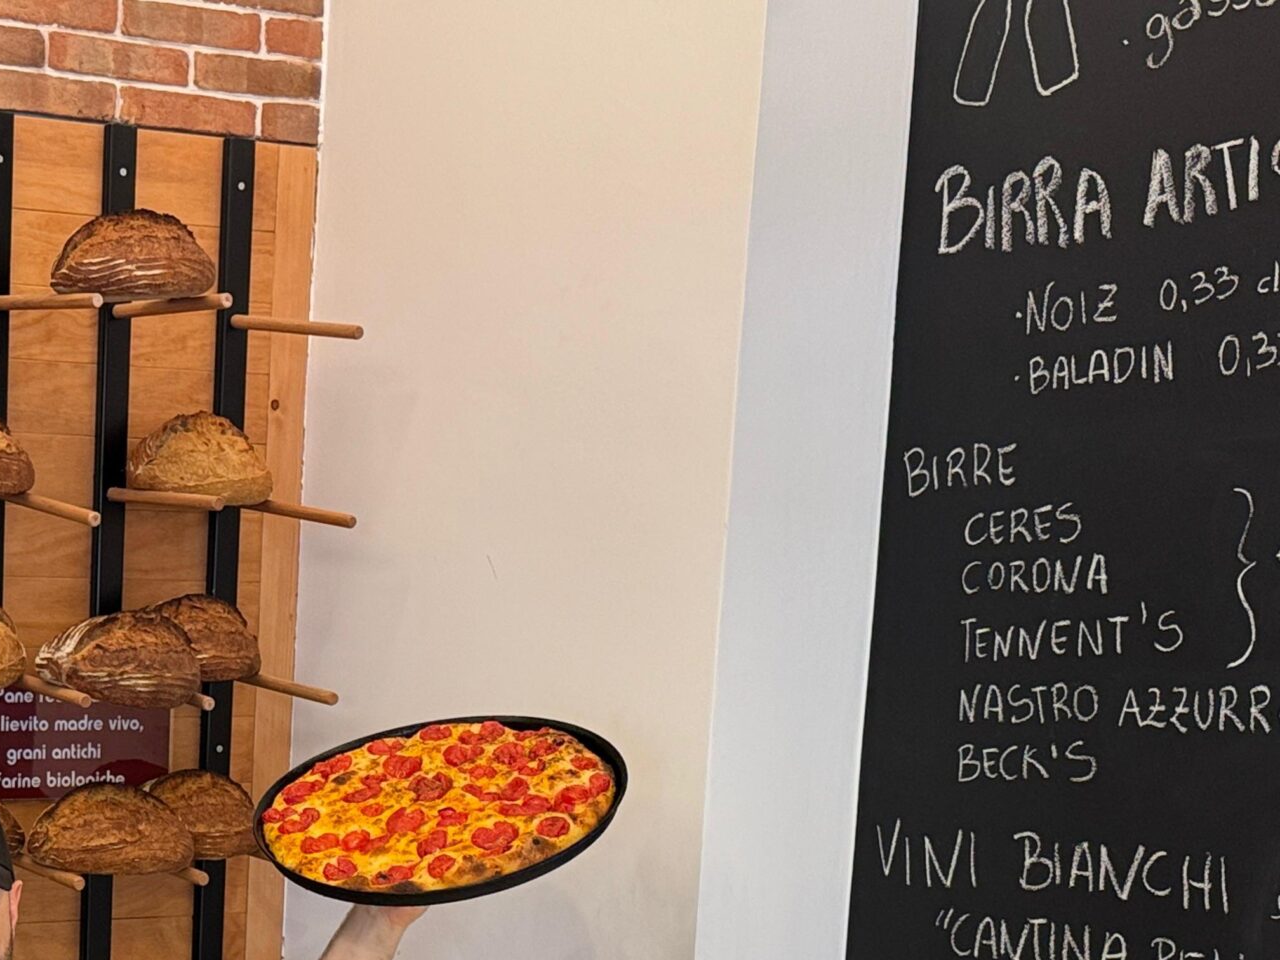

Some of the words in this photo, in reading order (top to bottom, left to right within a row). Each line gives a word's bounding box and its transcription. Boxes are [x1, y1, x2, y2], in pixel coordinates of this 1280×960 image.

[935, 155, 1112, 254] BIRRA
[1026, 281, 1118, 335] NOIZ
[1159, 266, 1239, 313] 0,33
[1029, 340, 1174, 395] BALADIN
[904, 443, 1017, 497] BIRRE
[964, 502, 1082, 545] CERES
[961, 552, 1109, 595] CORONA
[960, 601, 1184, 663] TENNENT'S
[0, 715, 49, 732] lievito
[54, 714, 103, 732] madre
[108, 716, 144, 733] vivo,
[959, 681, 1099, 725] NASTRO
[1118, 684, 1280, 734] AZZURR
[6, 744, 47, 766] grani
[52, 742, 102, 760] antichi
[958, 740, 1098, 783] BECK'S
[876, 818, 977, 888] VINI
[1013, 831, 1230, 914] BIANCHI
